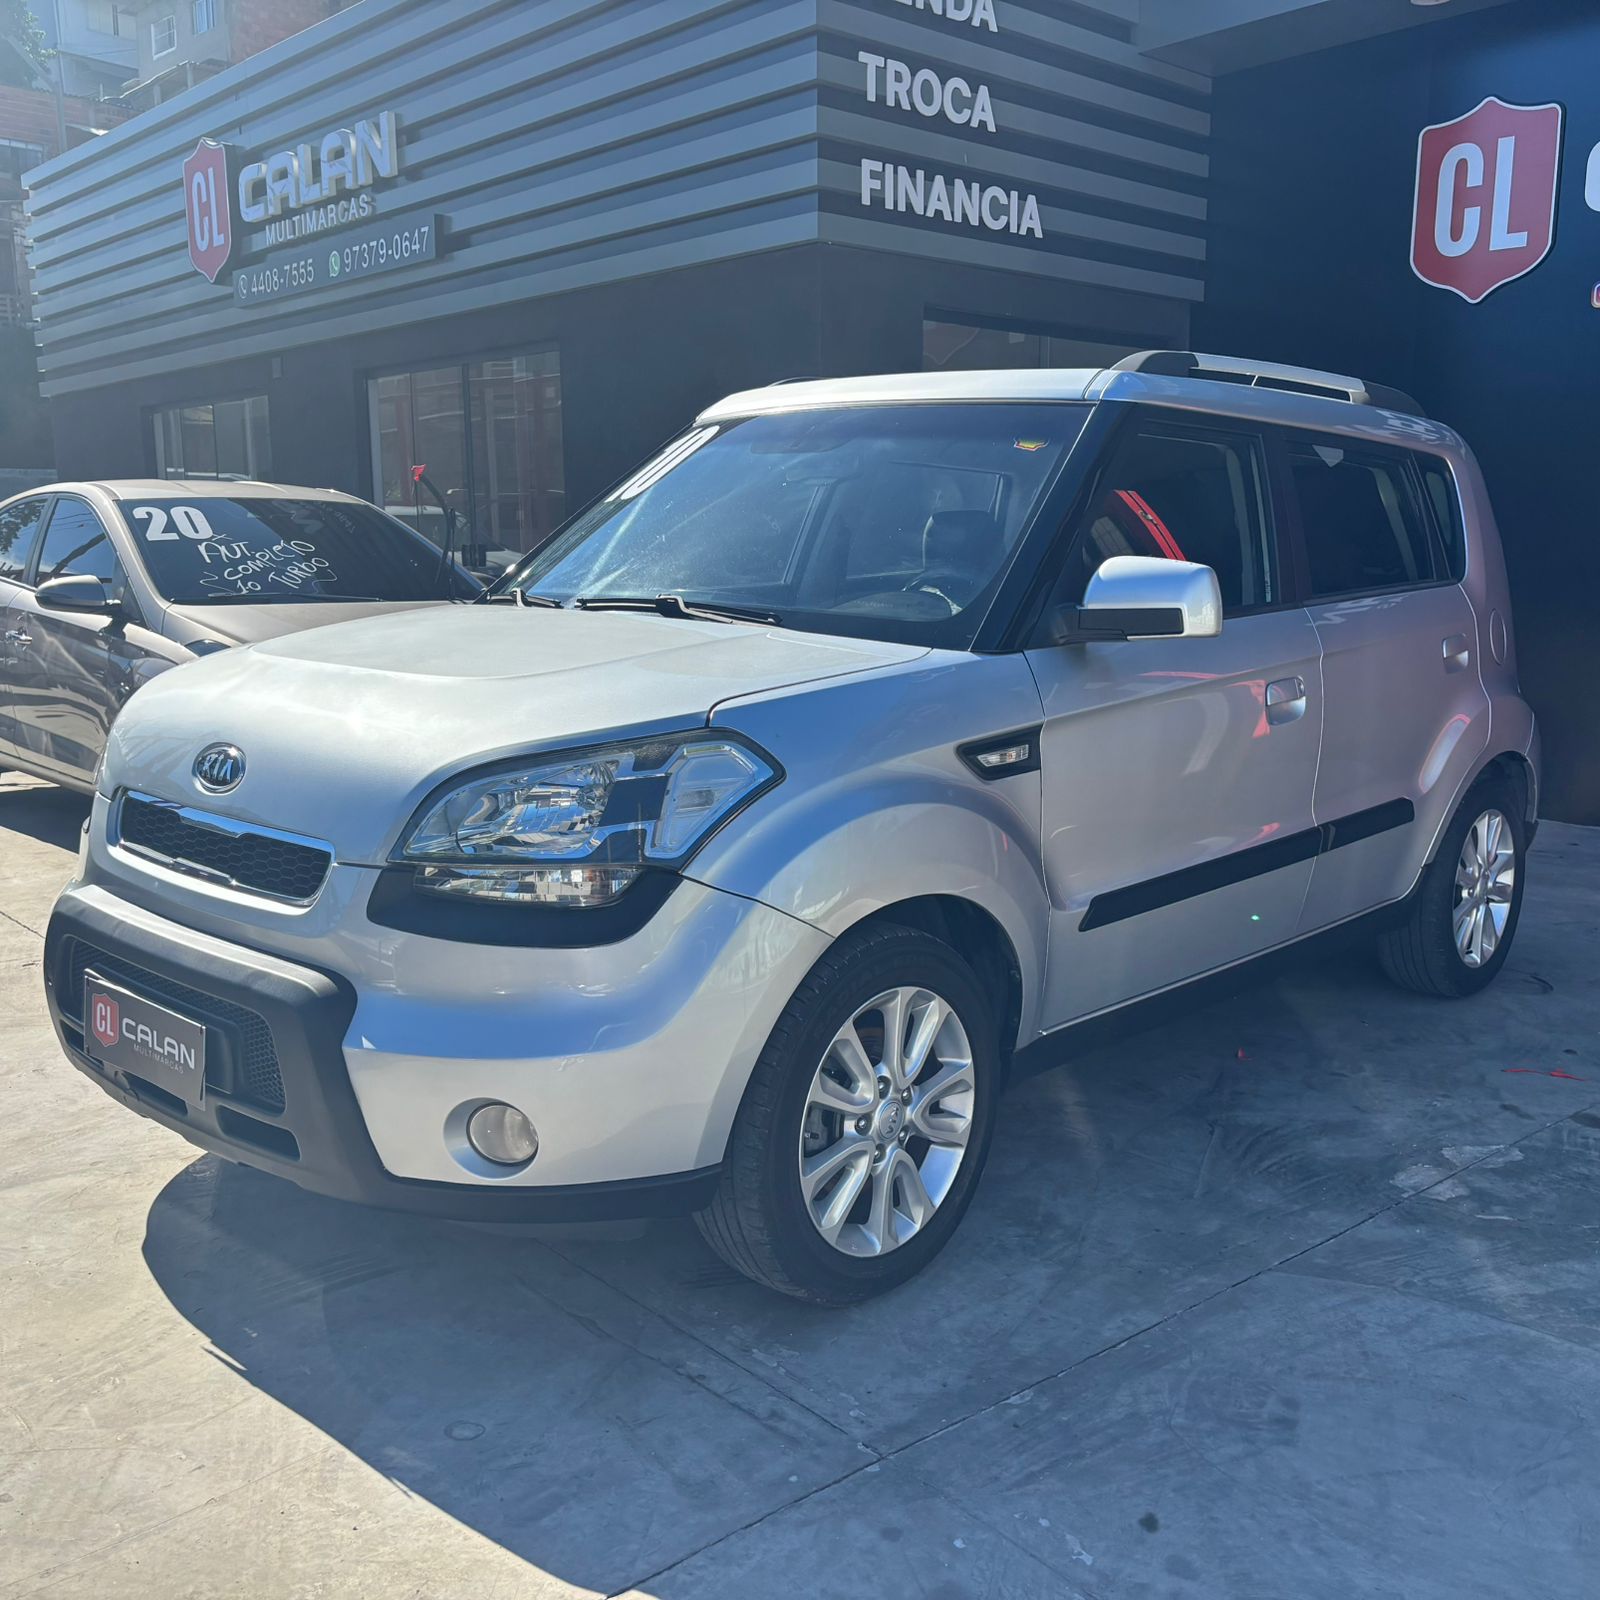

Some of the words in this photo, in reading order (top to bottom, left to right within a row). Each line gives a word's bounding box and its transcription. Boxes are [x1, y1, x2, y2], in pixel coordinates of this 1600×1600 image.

[858, 51, 996, 132] TROCA
[238, 110, 398, 223] CALAN
[861, 158, 1043, 238] FINANCIA
[1434, 136, 1528, 257] CL
[192, 167, 225, 251] CL
[265, 193, 374, 246] MULTIMARCAS
[251, 258, 314, 295] 4408-7555
[343, 226, 430, 272] 97379-0647
[132, 506, 213, 541] 20
[96, 1002, 115, 1037] CL
[122, 1017, 195, 1070] CALAN
